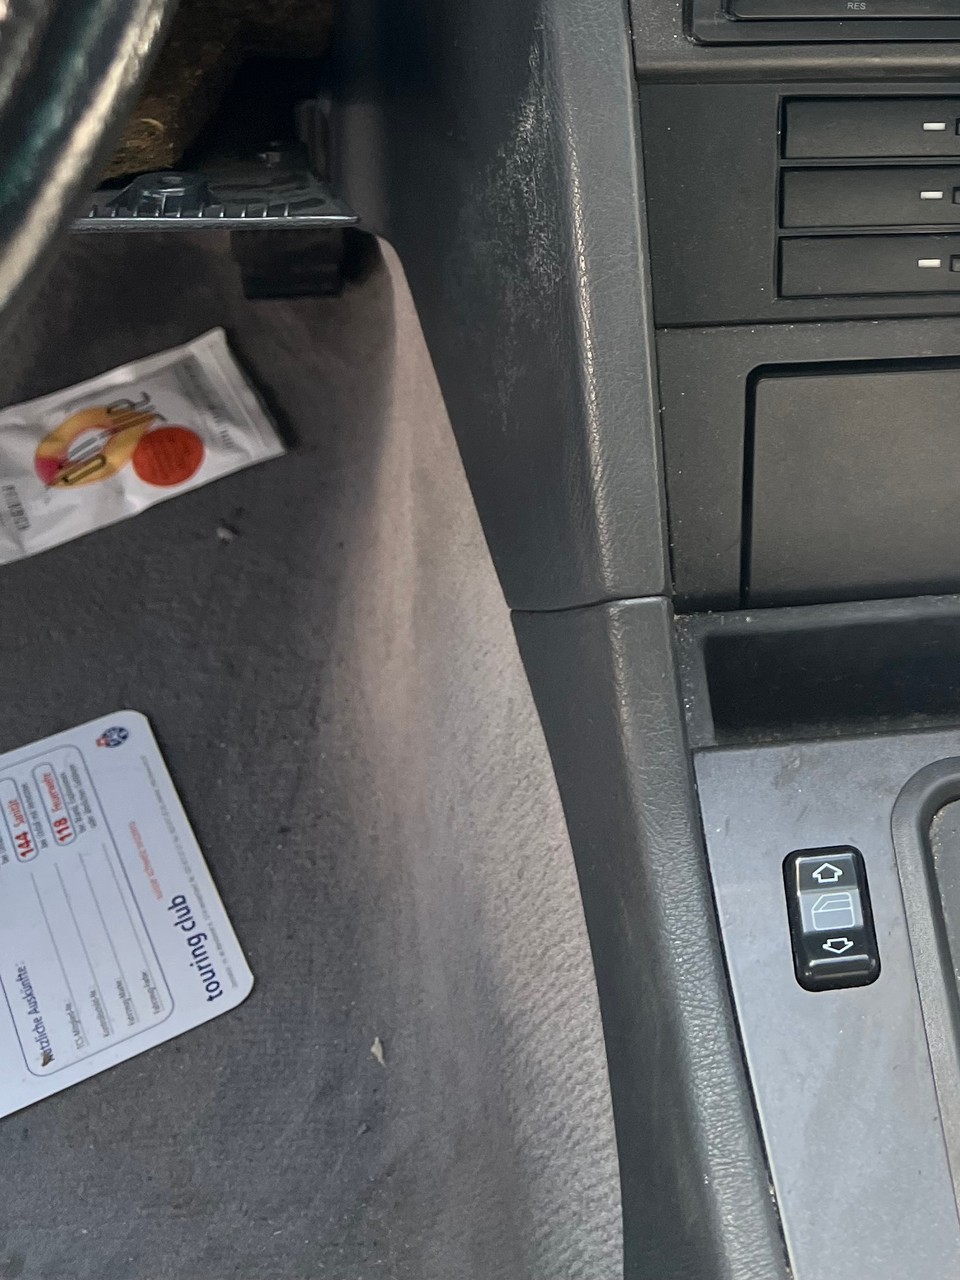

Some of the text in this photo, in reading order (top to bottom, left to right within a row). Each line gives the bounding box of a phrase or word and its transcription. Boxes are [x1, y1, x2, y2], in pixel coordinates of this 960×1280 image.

[847, 1, 866, 11] RES
[53, 817, 73, 842] 118
[15, 831, 34, 858] 144
[168, 893, 223, 1002] touring club
